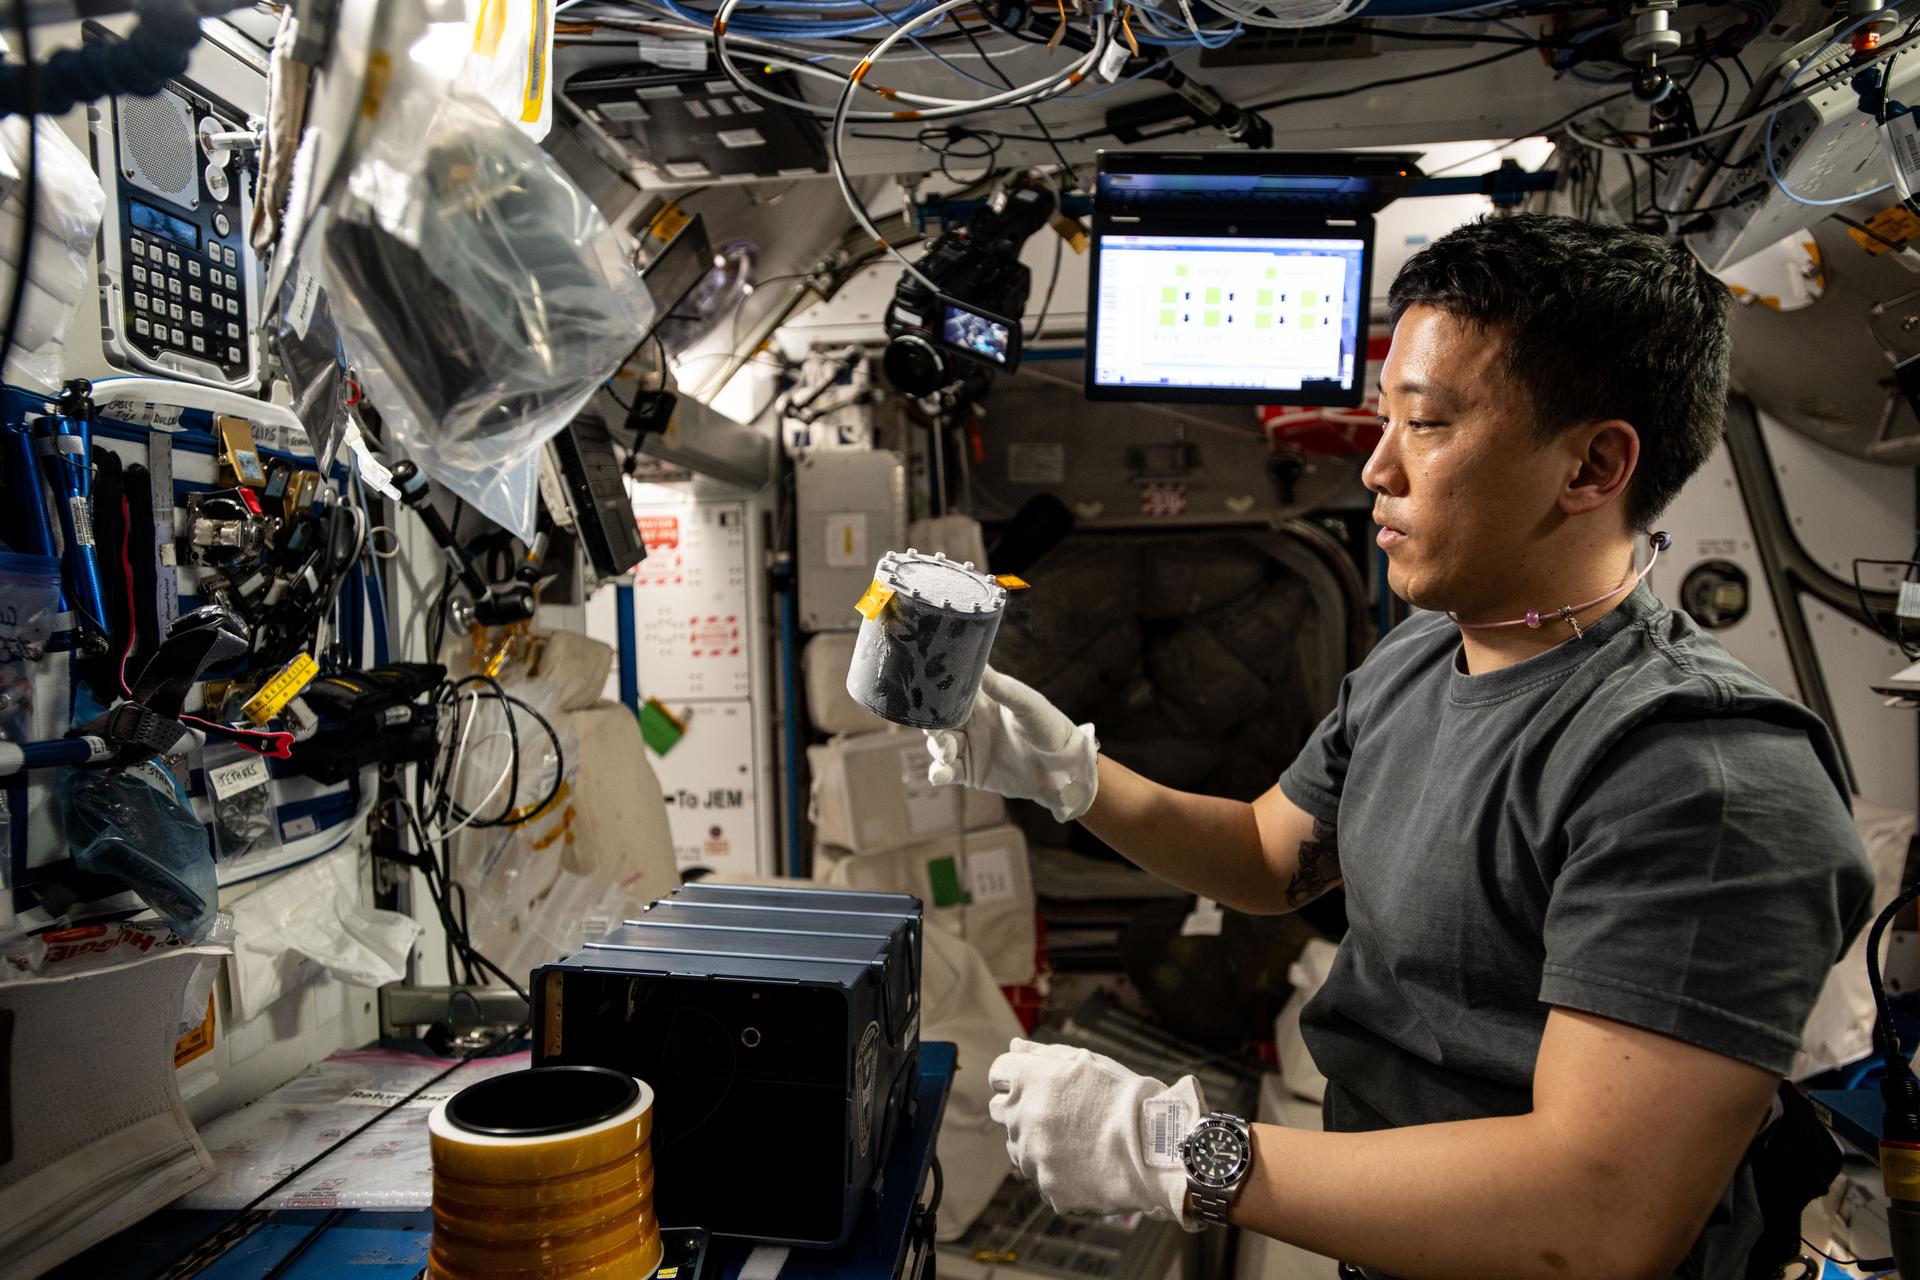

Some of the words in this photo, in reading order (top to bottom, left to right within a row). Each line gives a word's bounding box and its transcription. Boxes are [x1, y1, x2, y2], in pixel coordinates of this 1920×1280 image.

[108, 399, 135, 412] CABLE
[251, 425, 277, 441] CLIPS
[218, 764, 257, 787] TETHERS
[676, 790, 698, 809] To
[703, 789, 743, 809] JEM
